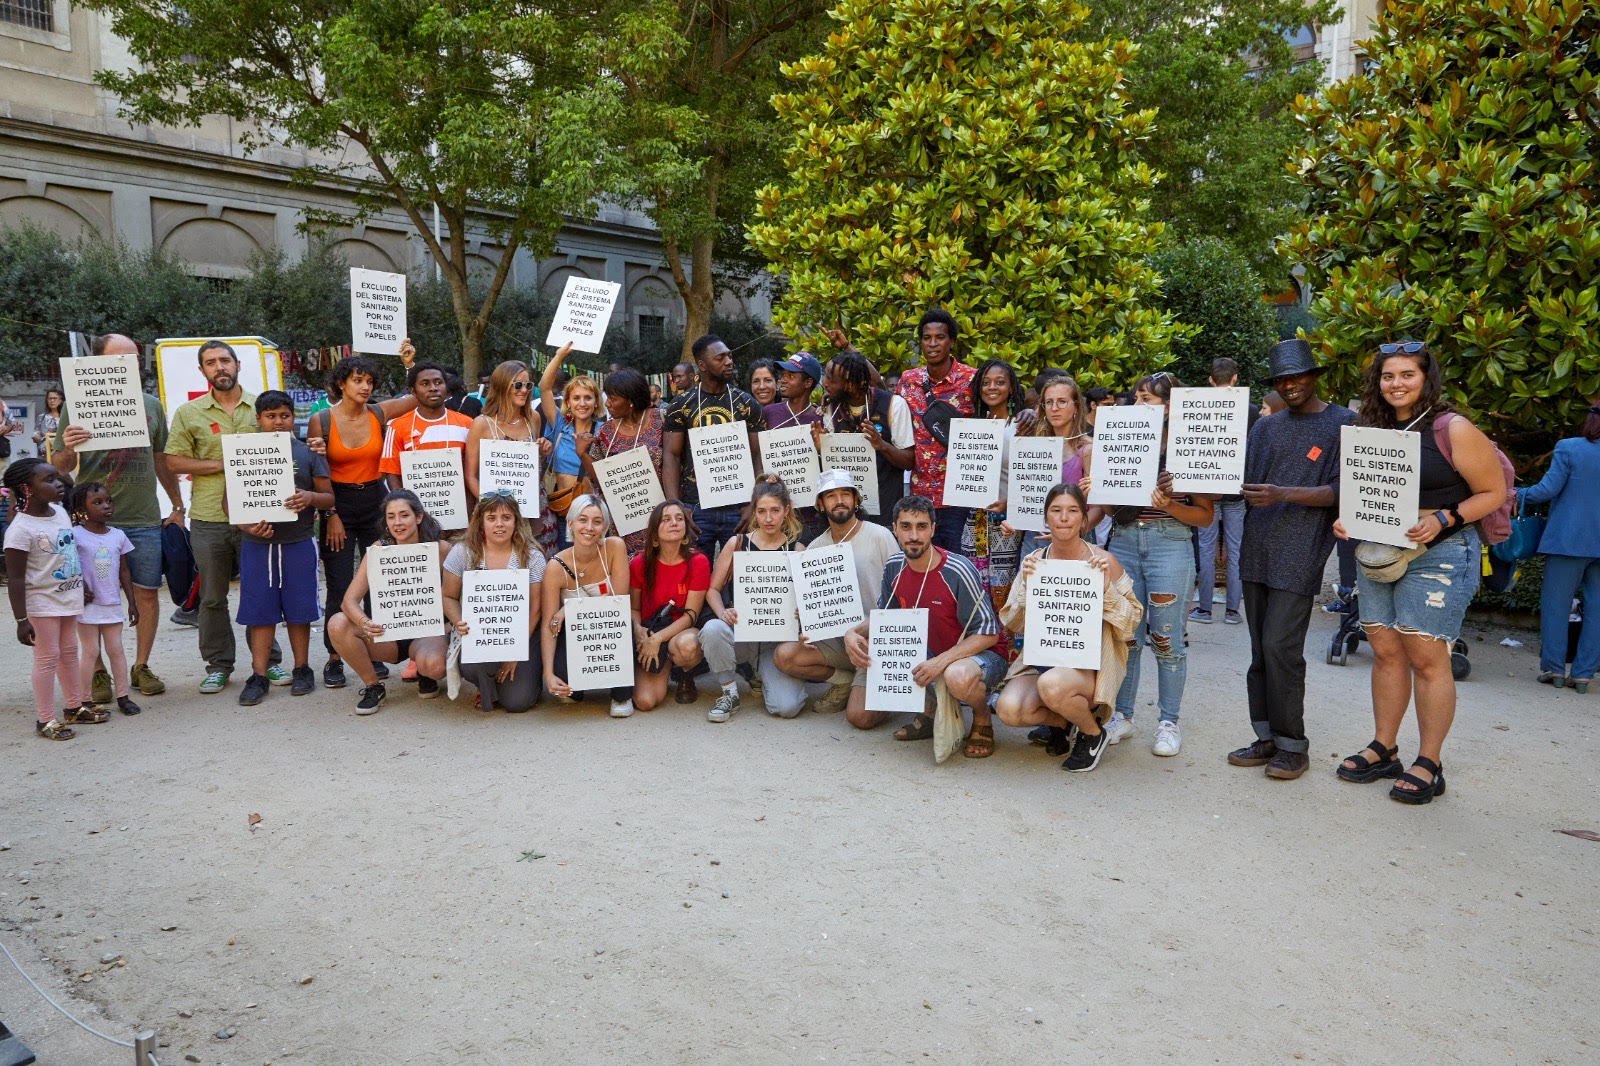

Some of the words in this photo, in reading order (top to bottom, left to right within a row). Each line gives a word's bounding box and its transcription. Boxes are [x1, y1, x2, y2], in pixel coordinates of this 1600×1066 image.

[361, 282, 397, 292] EXCLUIDO
[355, 291, 370, 299] DEL
[371, 293, 402, 303] SISTEMA
[360, 301, 398, 312] SANITARIO
[366, 312, 381, 320] POR
[368, 322, 392, 330] TENER
[364, 331, 396, 340] PAPELES
[74, 366, 127, 375] EXCLUDED
[77, 378, 106, 386] FROM
[85, 388, 122, 396] HEALTH
[74, 399, 114, 408] SYSTEM
[116, 398, 136, 406] FOR
[1182, 400, 1235, 408] EXCLUDED
[77, 411, 98, 419] NOT
[100, 408, 136, 418] HAVING
[1182, 412, 1211, 420] FROM
[1213, 412, 1233, 420] THE
[92, 420, 125, 429] LEGAL
[1188, 424, 1226, 432] HEALTH
[700, 434, 738, 446] EXCLUIDO
[1117, 432, 1155, 440] SISTEMA
[1175, 436, 1214, 444] SYSTEM
[1217, 437, 1238, 445] FOR
[696, 448, 712, 456] DEL
[712, 443, 745, 453] SISTEMA
[967, 442, 998, 450] SISTEMA
[1102, 444, 1149, 452] SANITARIO
[235, 447, 280, 455] EXCLUIDA
[1175, 448, 1196, 456] NOT
[1198, 449, 1235, 457] HAVING
[1354, 445, 1405, 458] EXCLUIDO
[249, 457, 287, 465] SISTEMA
[702, 453, 742, 465] SANITARIO
[955, 453, 993, 461] SANITARIO
[1128, 456, 1141, 464] NO
[709, 465, 725, 473] POR
[1026, 462, 1057, 470] SISTEMA
[1188, 461, 1221, 469] LEGAL
[1346, 457, 1365, 468] DEL
[1368, 460, 1413, 473] SISTEMA
[236, 468, 283, 476] SANITARIO
[712, 473, 738, 482] TENER
[960, 473, 984, 481] TENER
[1016, 473, 1052, 481] SANITARIO
[1352, 471, 1406, 486] SANITARIO
[243, 479, 262, 487] POR
[710, 482, 744, 493] PAPELES
[955, 483, 987, 492] PAPELES
[1102, 479, 1141, 487] PAPELES
[1020, 484, 1035, 492] POR
[1359, 485, 1380, 496] POR
[1383, 489, 1398, 498] NO
[247, 489, 276, 497] TENER
[242, 499, 282, 508] PAPELES
[1022, 495, 1044, 503] TENER
[1361, 499, 1395, 512] TENER
[1018, 507, 1044, 516] PAPELE
[1355, 511, 1400, 526] PAPELES
[379, 554, 427, 564] EXCLUDED
[801, 554, 843, 568] EXCLUDED
[381, 566, 407, 575] FROM
[409, 565, 427, 573] THE
[803, 568, 827, 578] FROM
[828, 564, 844, 573] THE
[387, 576, 422, 586] HEALTH
[757, 575, 793, 583] SISTEMA
[810, 575, 841, 588] HEALTH
[1040, 576, 1090, 585] EXCLUIDO
[377, 588, 414, 598] SYSTEM
[416, 586, 434, 594] FOR
[474, 583, 517, 592] EXCLUIDA
[744, 586, 788, 594] SANITARIO
[802, 588, 834, 600] SYSTEM
[835, 584, 853, 594] FOR
[486, 594, 524, 602] SISTEMA
[1032, 588, 1051, 596] DEL
[1054, 589, 1097, 599] SISTEMA
[379, 600, 398, 608] NOT
[400, 597, 434, 607] HAVING
[805, 600, 821, 610] NOT
[823, 595, 853, 607] HAVING
[1038, 600, 1090, 611] SANITARIO
[472, 605, 519, 613] SANITARIO
[817, 608, 844, 619] LEGAL
[393, 609, 422, 619] LEGAL
[576, 610, 620, 619] EXCLUIDO
[1044, 613, 1065, 622] POR
[1068, 615, 1082, 623] NO
[381, 618, 441, 630] OCUMENTATION
[479, 616, 497, 624] POR
[499, 615, 512, 623] NO
[804, 615, 861, 631] DOCUMENTATION
[570, 623, 587, 631] DEL
[589, 620, 626, 629] SISTEMA
[1046, 626, 1079, 636] TENER
[576, 631, 622, 641] SANITARIO
[475, 637, 514, 646] PAPELES
[1040, 638, 1084, 649] PAPELES
[583, 644, 601, 652] POR
[603, 642, 616, 650] NO
[586, 653, 614, 662] TENER
[876, 649, 917, 657] SANITARIO
[581, 664, 620, 674] PAPELES
[881, 661, 898, 669] POR
[899, 661, 911, 670] NO
[883, 673, 909, 682] TENER
[878, 685, 912, 694] PAPELES
